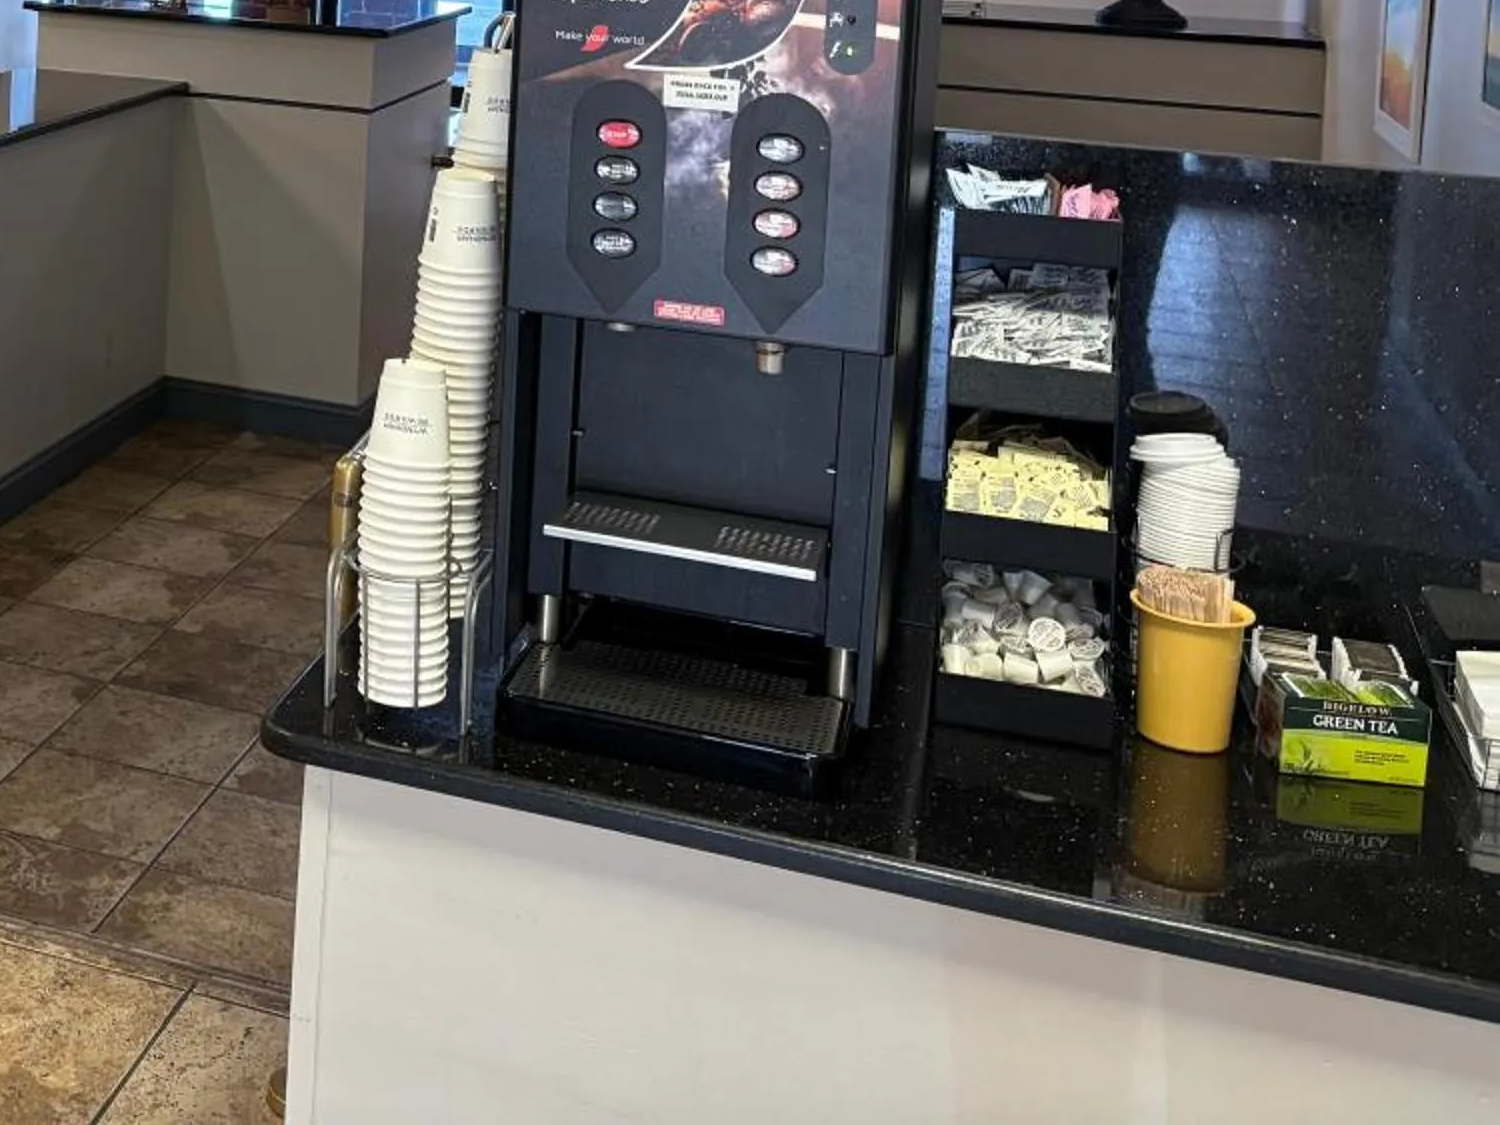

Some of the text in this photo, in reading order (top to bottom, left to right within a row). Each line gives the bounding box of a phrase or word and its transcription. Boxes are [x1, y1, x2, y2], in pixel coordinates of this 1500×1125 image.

[555, 30, 644, 46] Make your world
[1323, 701, 1391, 716] BIGELOW
[1312, 714, 1399, 736] GREEN TEA
